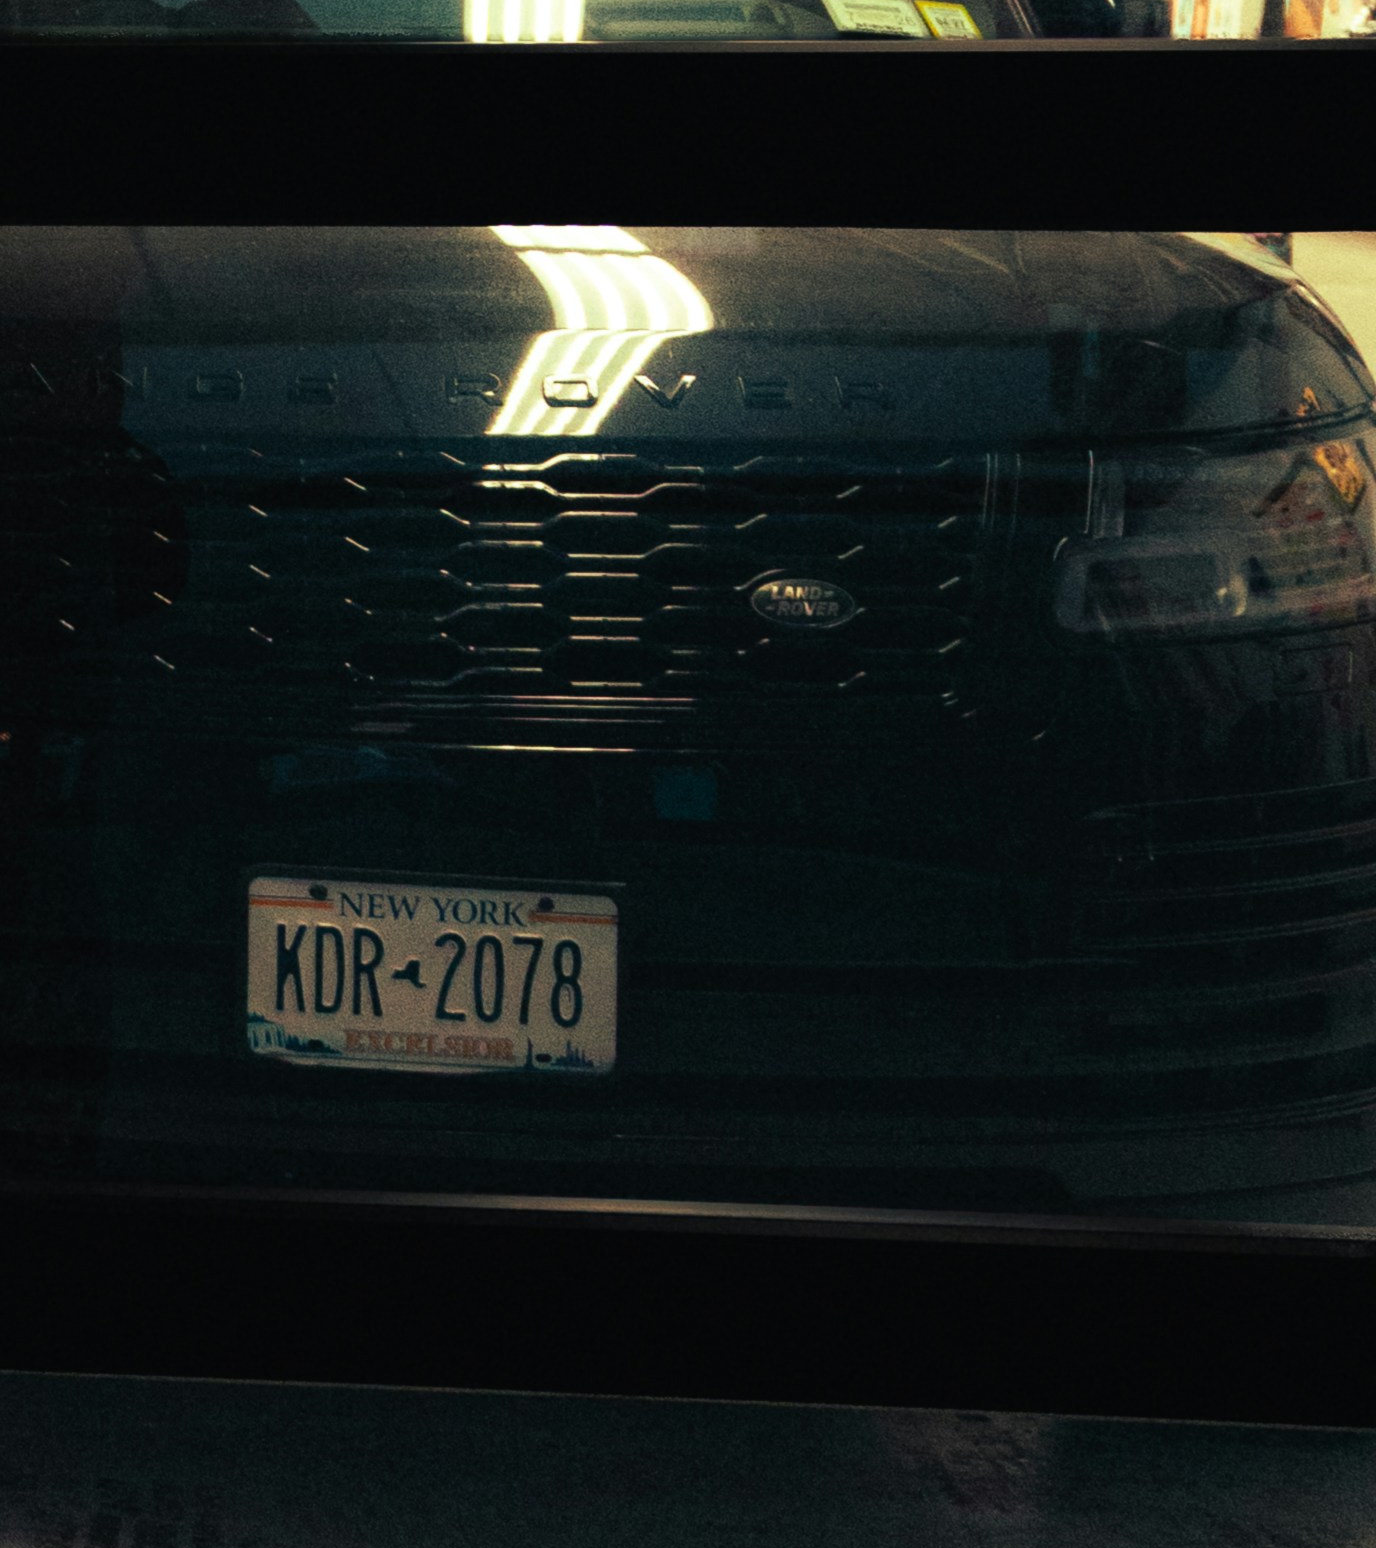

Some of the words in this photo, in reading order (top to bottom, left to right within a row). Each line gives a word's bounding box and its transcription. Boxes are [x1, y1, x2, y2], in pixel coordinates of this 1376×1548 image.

[451, 373, 898, 408] ROVER
[338, 892, 420, 923] NEW
[428, 897, 530, 928] YORK
[276, 923, 384, 1018] KDR
[434, 931, 585, 1030] 2078
[344, 1029, 515, 1062] EXCELSIOR
